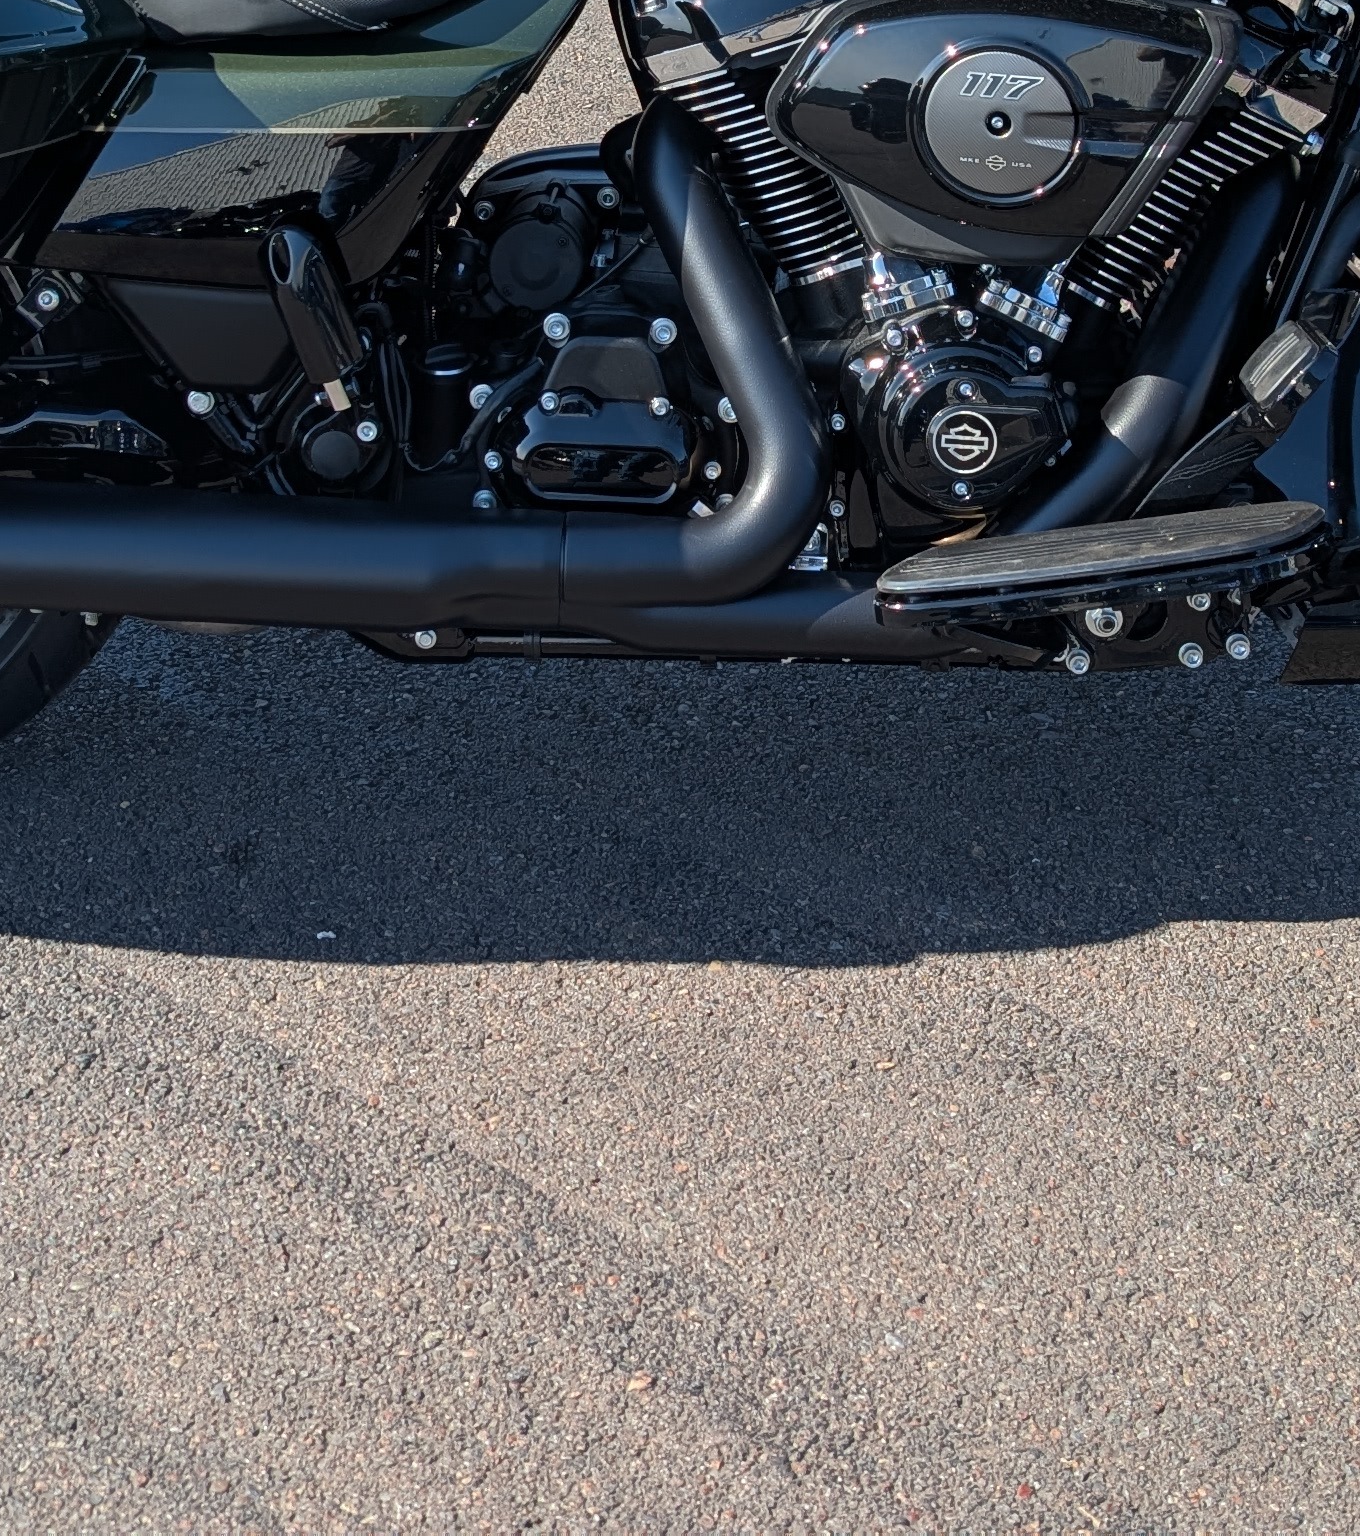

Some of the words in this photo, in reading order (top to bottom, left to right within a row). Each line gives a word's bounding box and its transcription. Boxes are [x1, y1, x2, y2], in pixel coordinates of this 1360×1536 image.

[959, 71, 1045, 101] 117
[959, 156, 980, 164] MKE
[1011, 161, 1032, 169] USA
